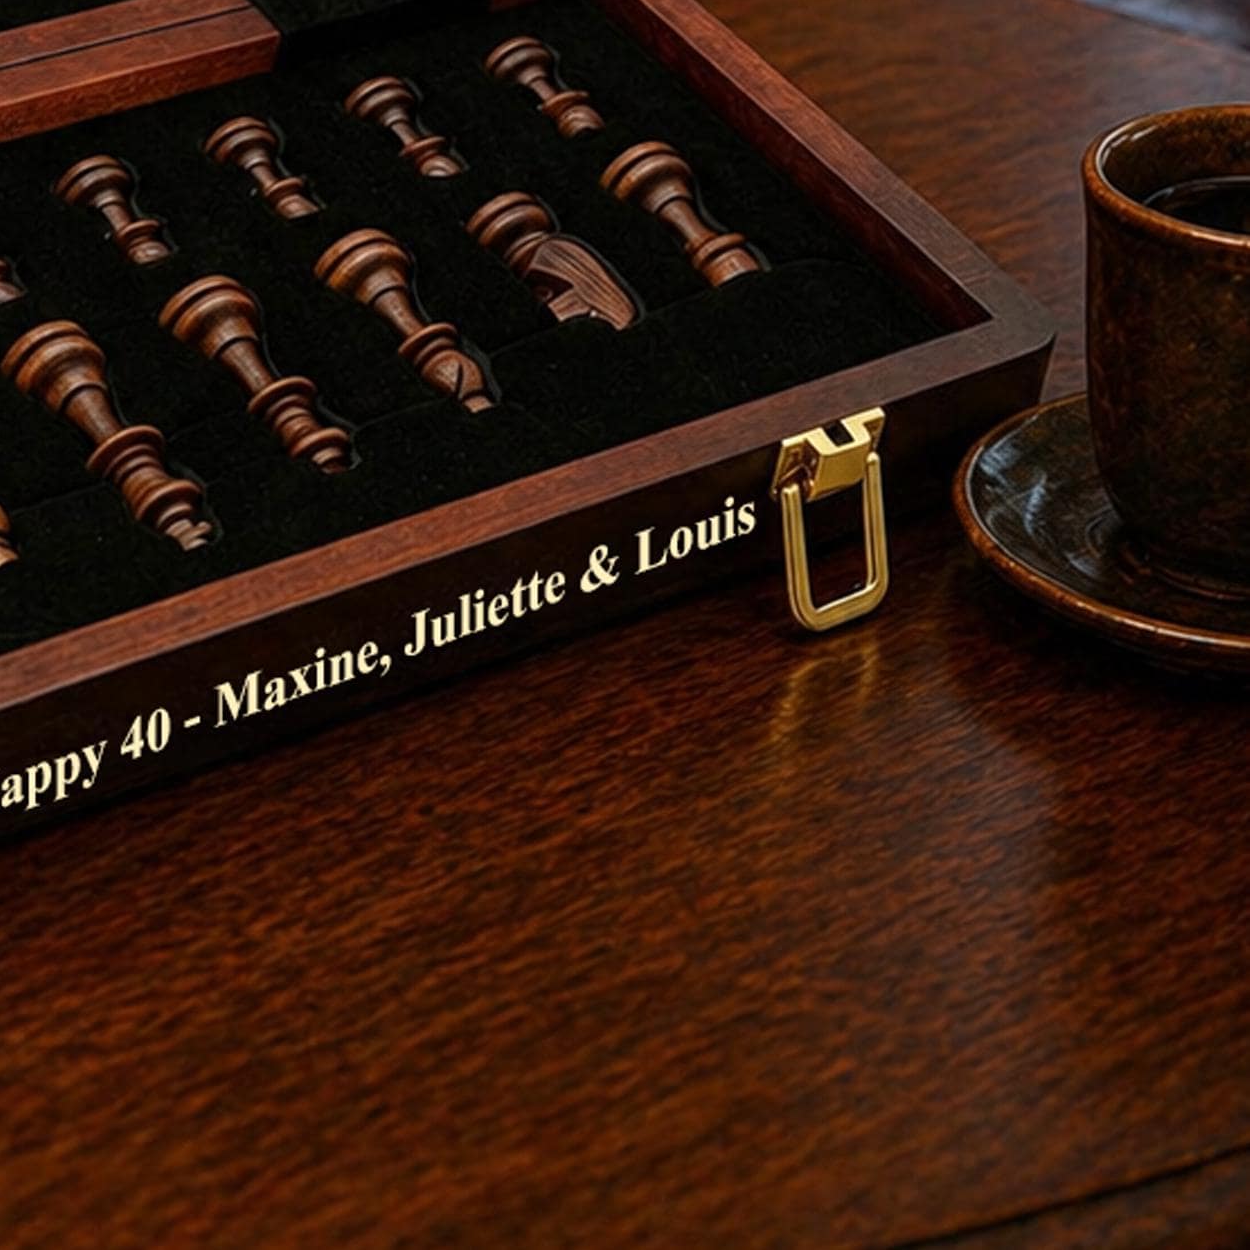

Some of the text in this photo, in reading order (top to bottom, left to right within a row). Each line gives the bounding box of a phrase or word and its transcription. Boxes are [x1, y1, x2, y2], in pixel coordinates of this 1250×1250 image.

[120, 708, 170, 759] 40
[184, 716, 201, 728] -
[216, 641, 391, 727] Maxine,
[404, 571, 566, 656] Juliette
[580, 545, 620, 593] &
[637, 497, 755, 573] Louis
